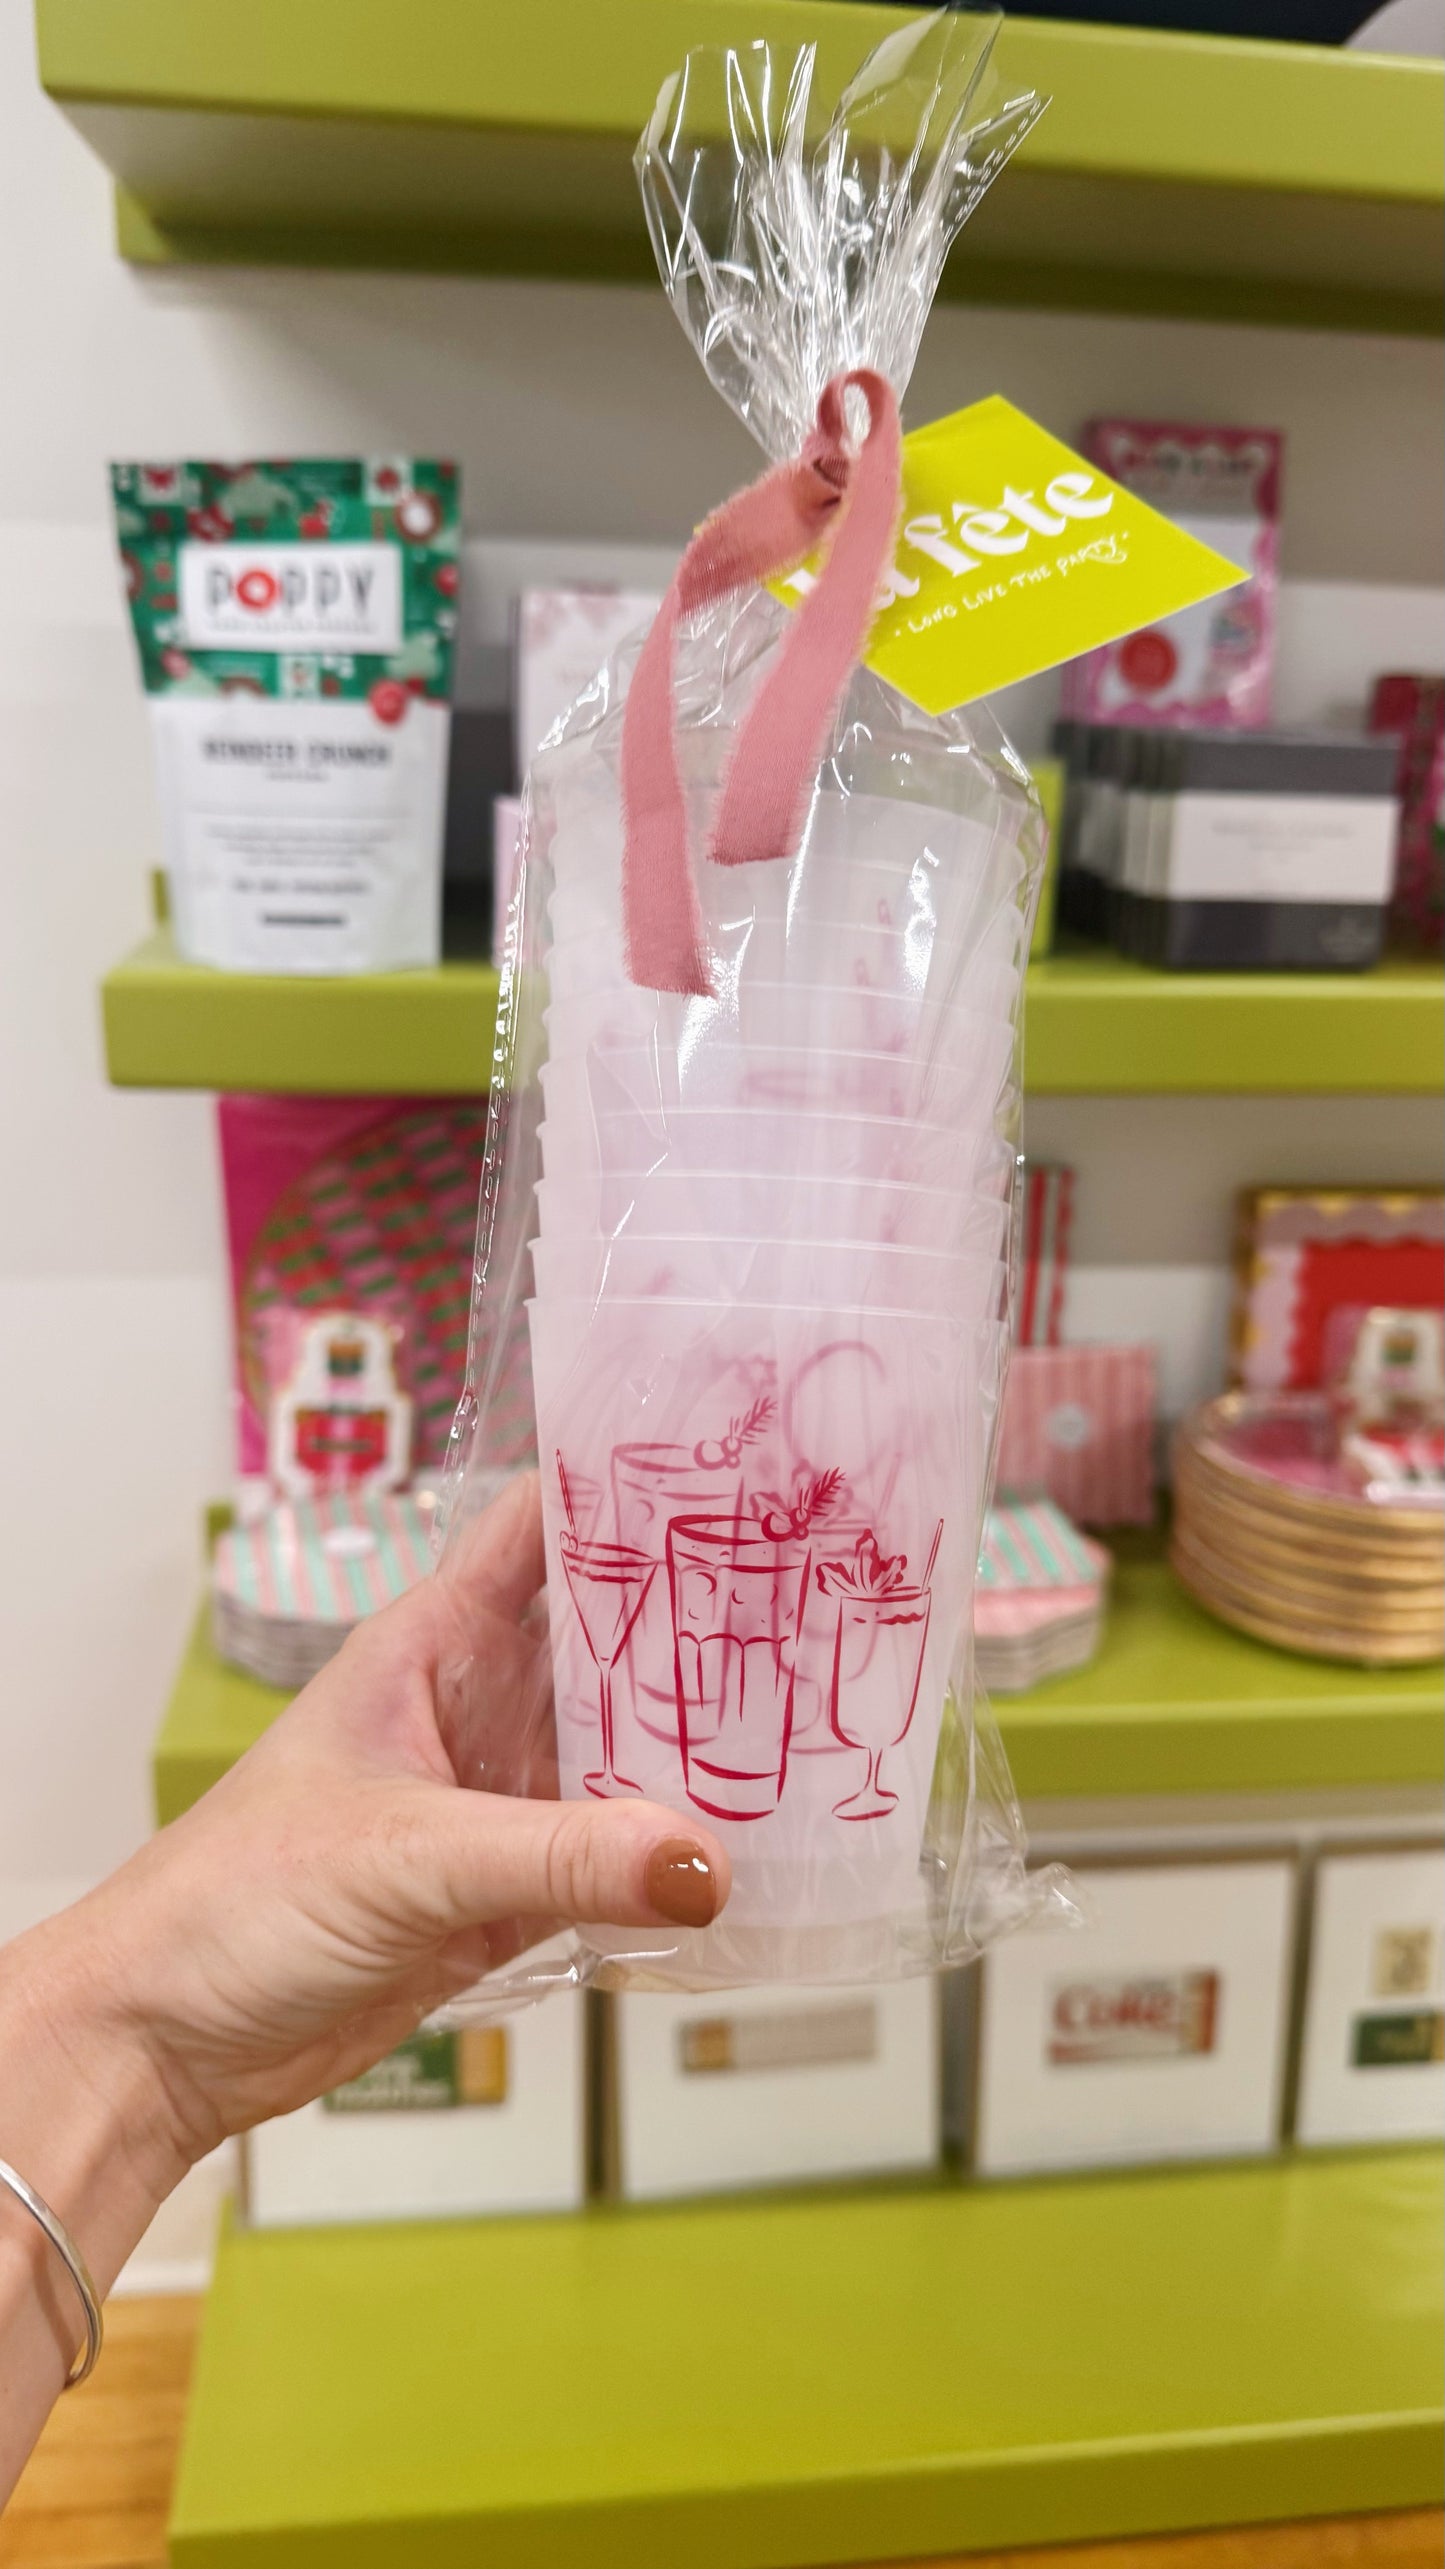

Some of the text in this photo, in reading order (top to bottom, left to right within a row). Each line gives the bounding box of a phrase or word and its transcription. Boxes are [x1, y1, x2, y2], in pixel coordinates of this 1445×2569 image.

[904, 473, 1115, 578] fête
[206, 563, 375, 616] POPPY
[907, 534, 1128, 634] LONG LIVE THE PARTY
